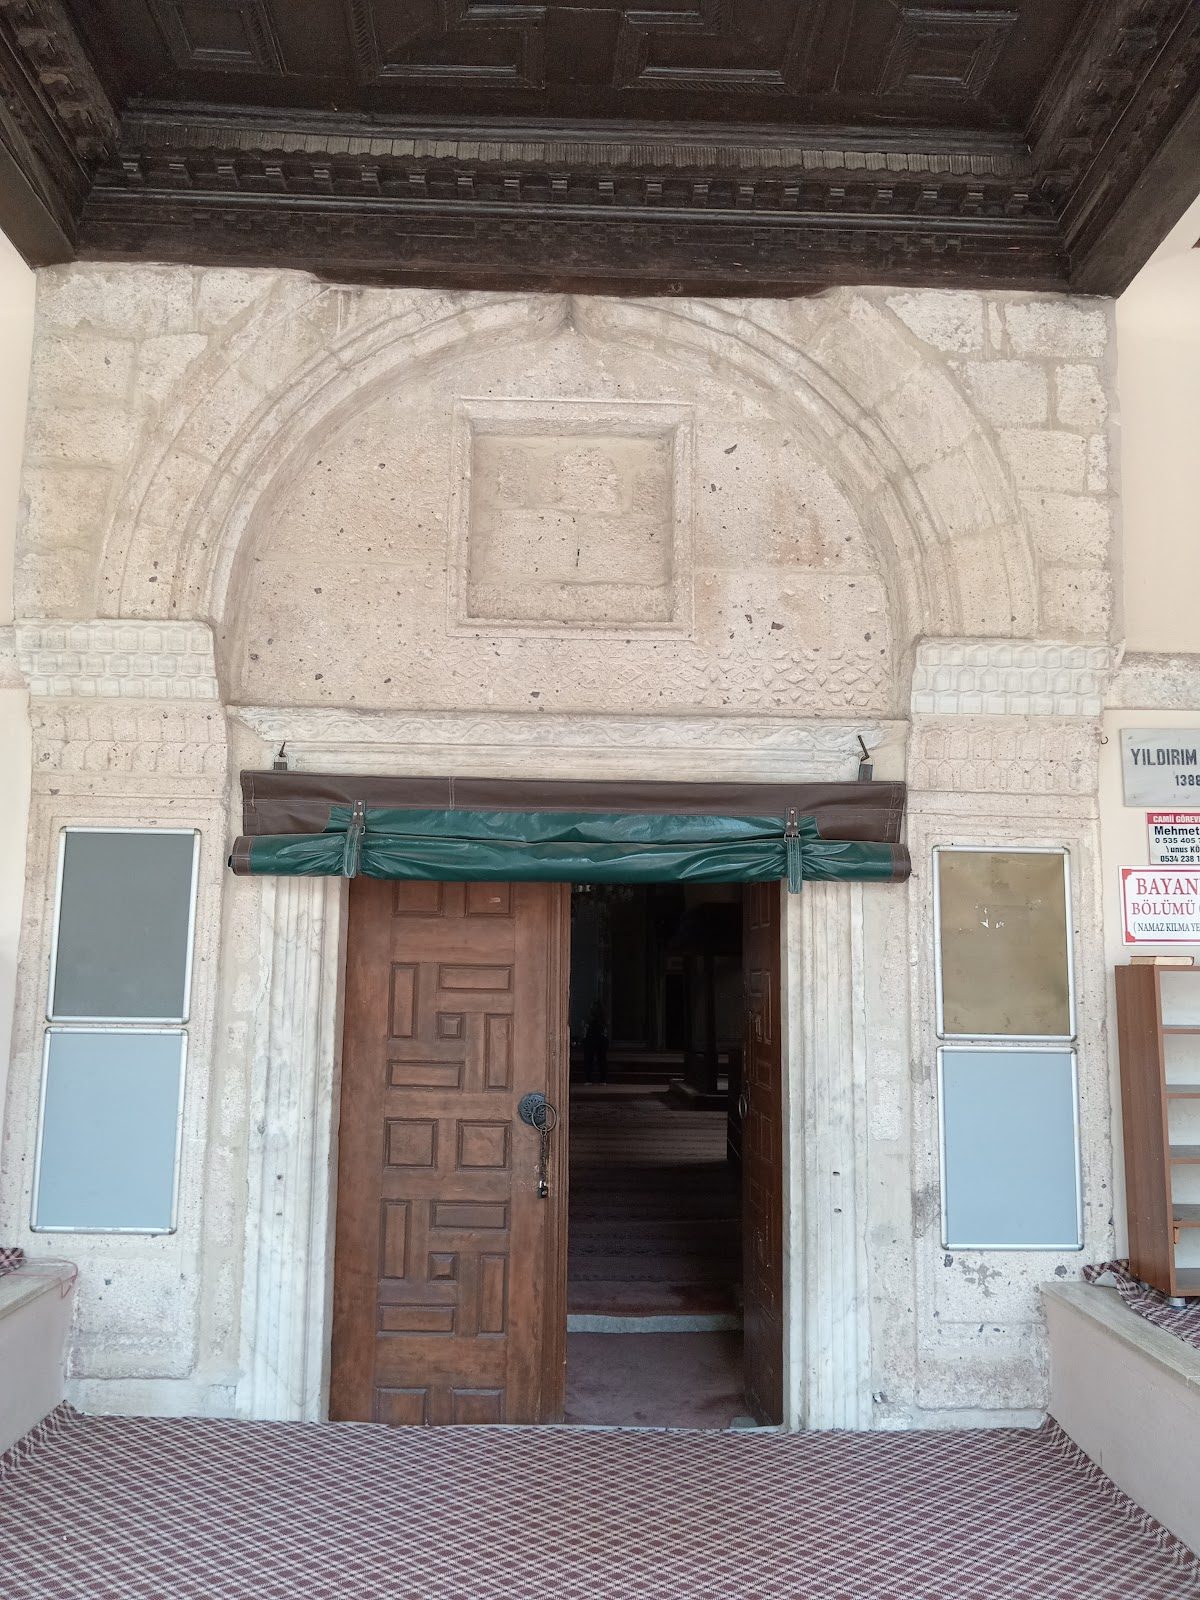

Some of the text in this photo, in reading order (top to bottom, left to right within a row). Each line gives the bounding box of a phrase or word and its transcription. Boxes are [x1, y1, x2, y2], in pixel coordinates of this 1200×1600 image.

[1130, 749, 1197, 765] YILDIRIM
[1154, 826, 1199, 836] Mehmet
[1160, 855, 1178, 863] 0534
[1181, 855, 1194, 863] 238
[1136, 878, 1198, 895] BAYAN
[1131, 899, 1196, 916] BÖLÜMÜ
[1166, 922, 1190, 932] KILMA
